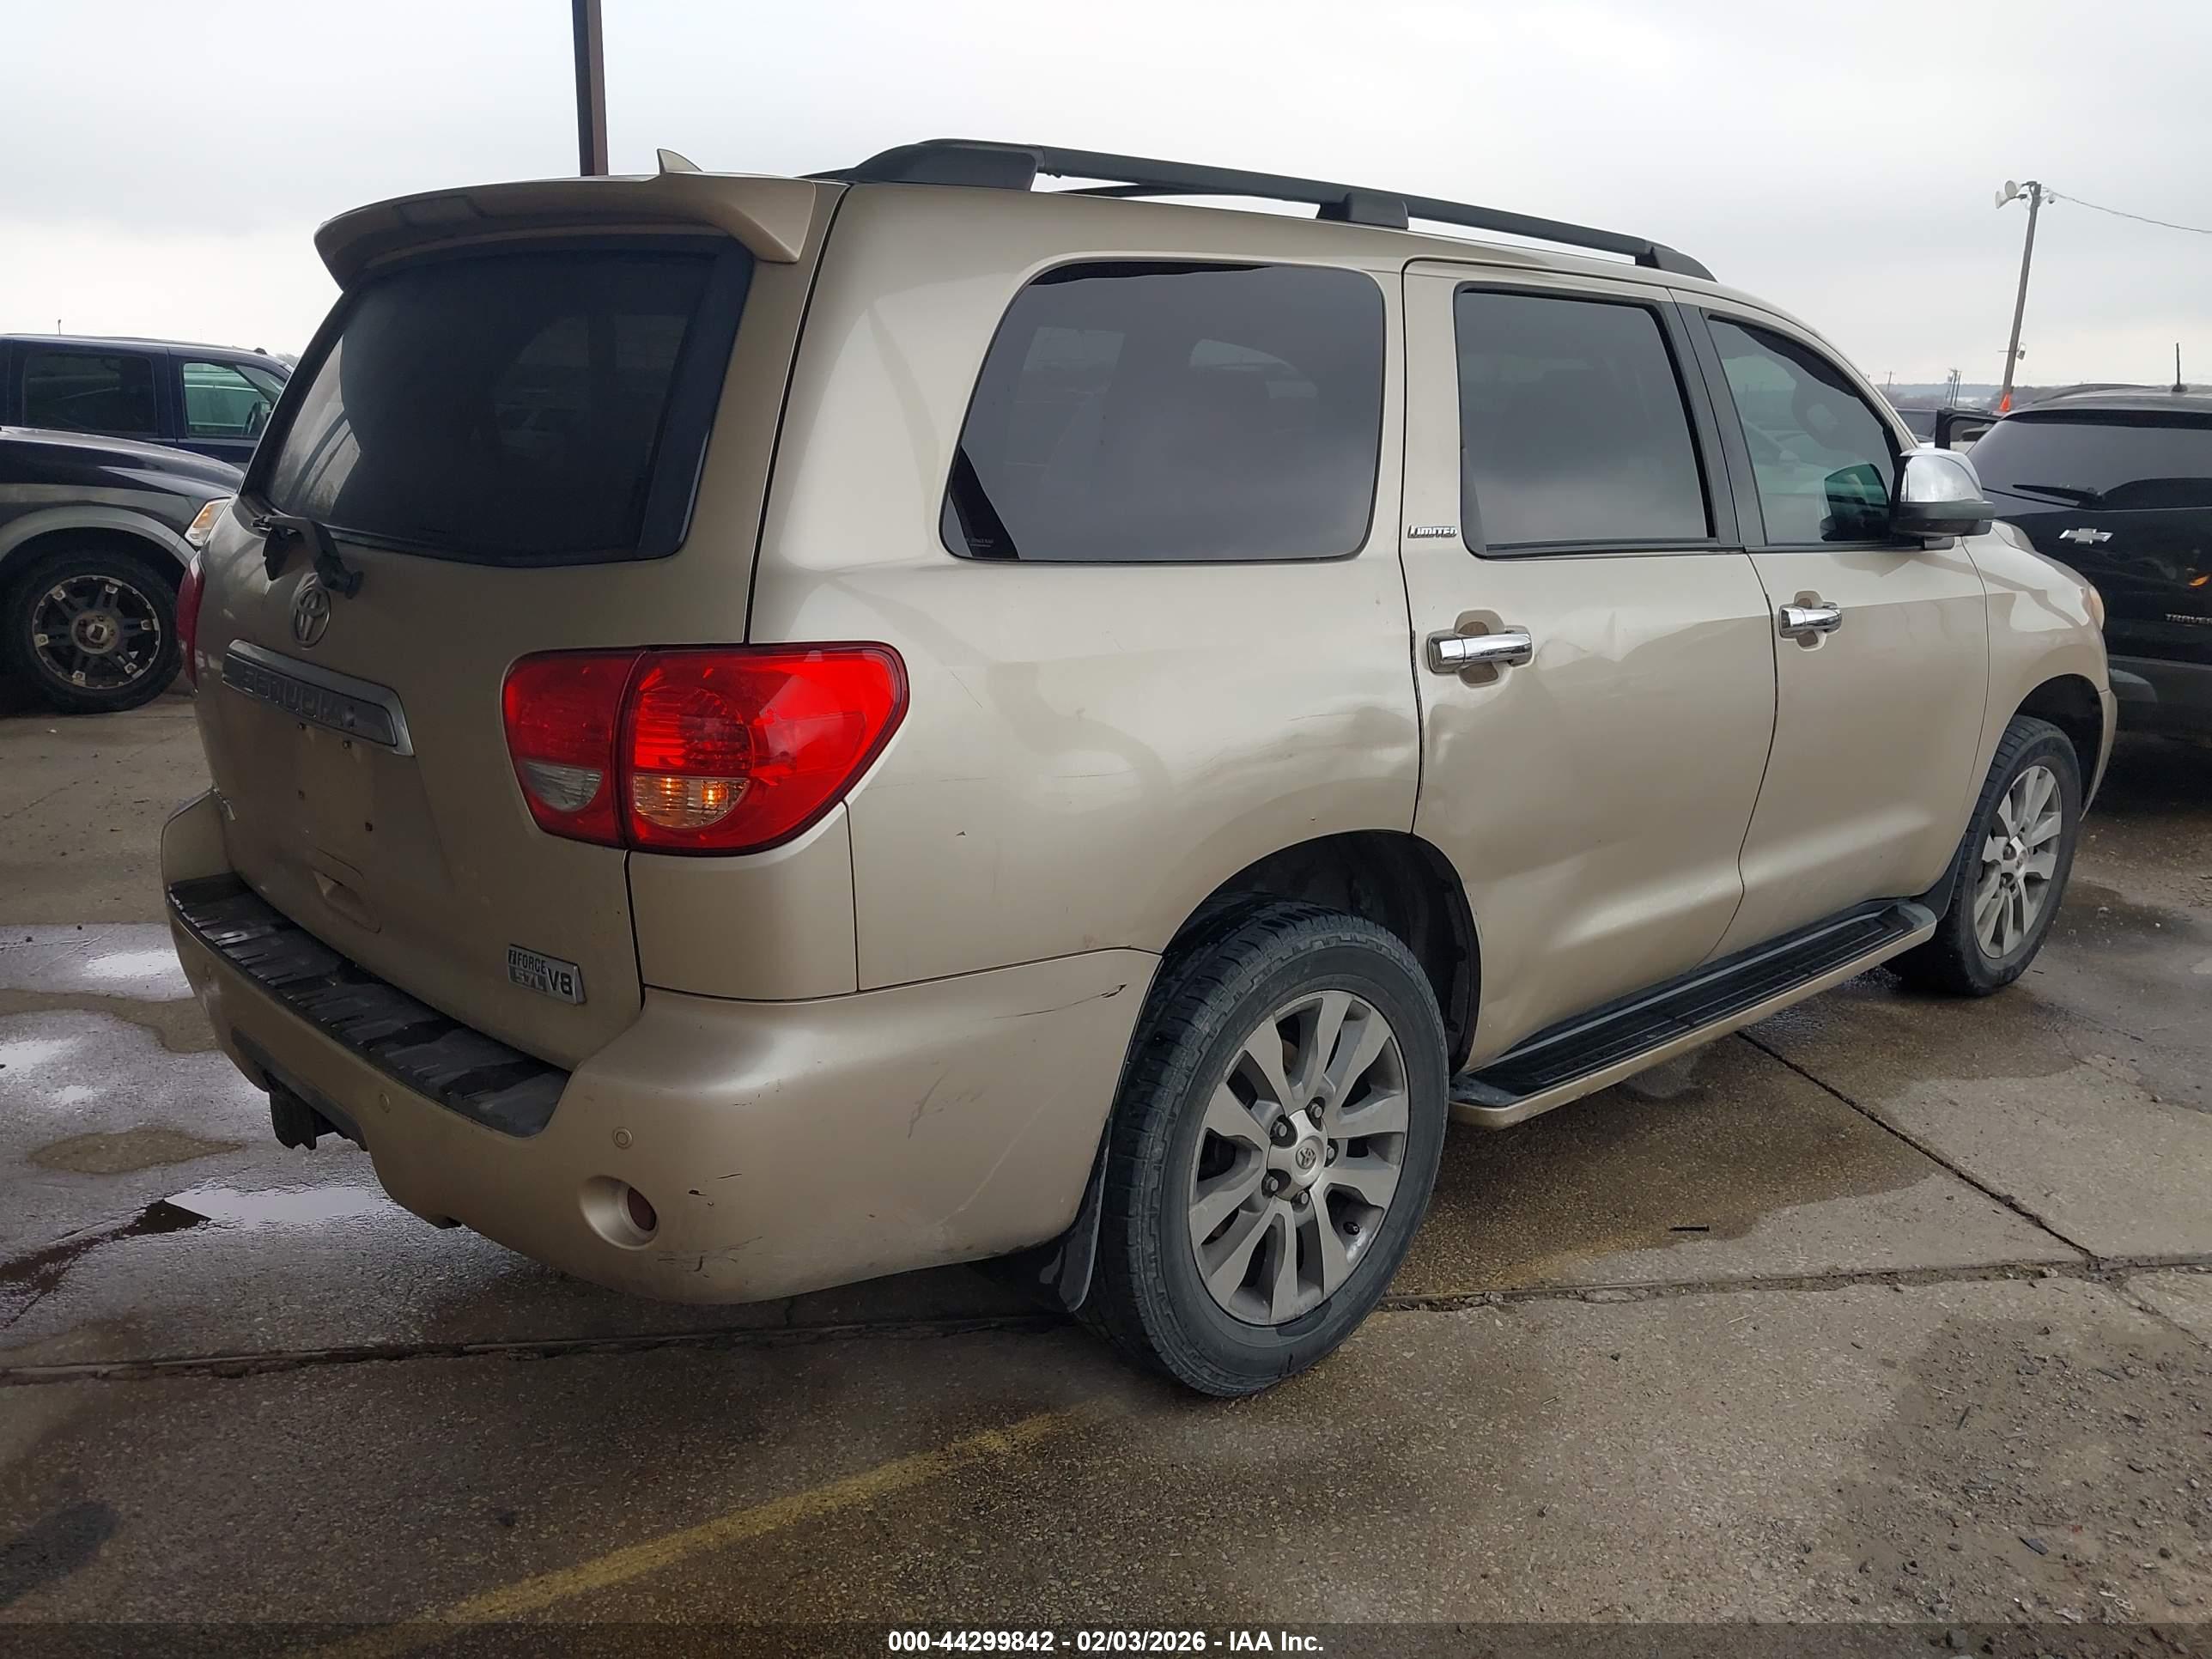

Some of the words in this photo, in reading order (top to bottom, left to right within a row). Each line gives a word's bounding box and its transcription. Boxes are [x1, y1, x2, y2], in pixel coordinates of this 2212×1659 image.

[1407, 525, 1457, 538] LIMITED
[240, 667, 349, 727] SEQUOIA
[547, 968, 573, 996] V8
